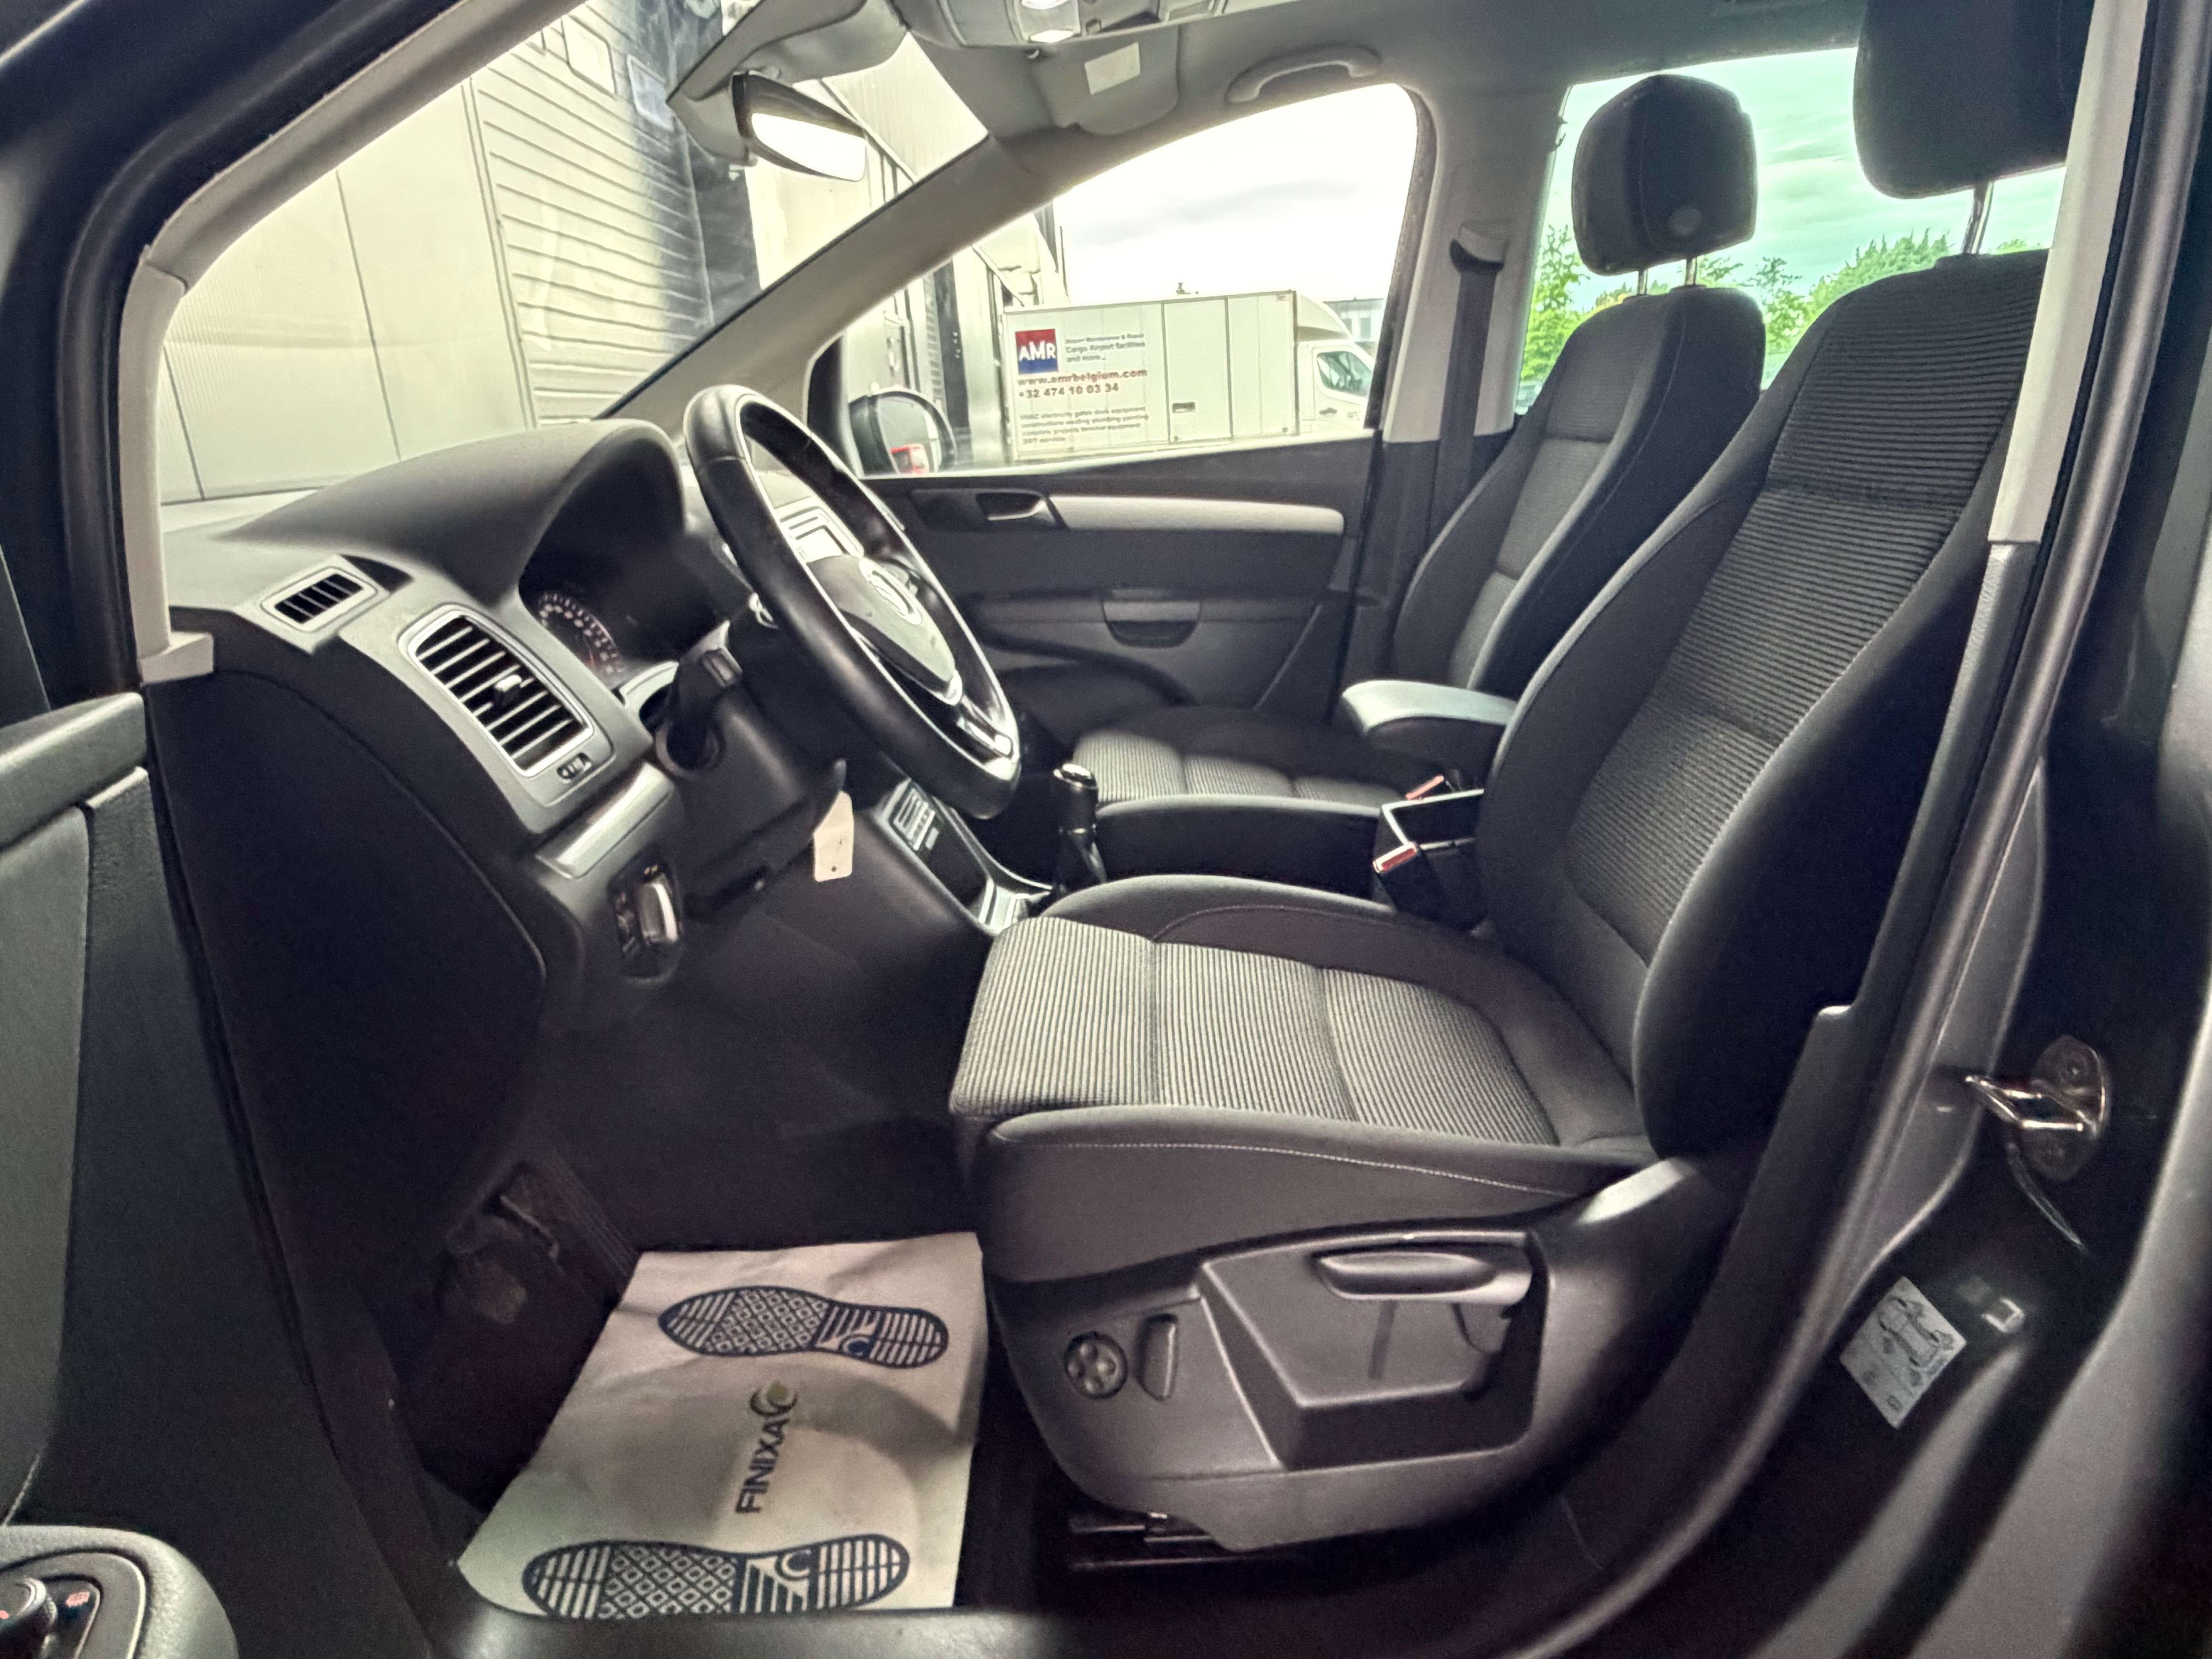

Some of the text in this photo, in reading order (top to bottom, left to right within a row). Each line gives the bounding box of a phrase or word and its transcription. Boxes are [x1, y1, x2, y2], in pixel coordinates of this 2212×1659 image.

[1019, 340, 1056, 361] AMR
[1043, 387, 1065, 396] 474
[1086, 384, 1101, 394] 03
[1104, 382, 1119, 393] 34
[735, 1417, 791, 1514] FINIXA
